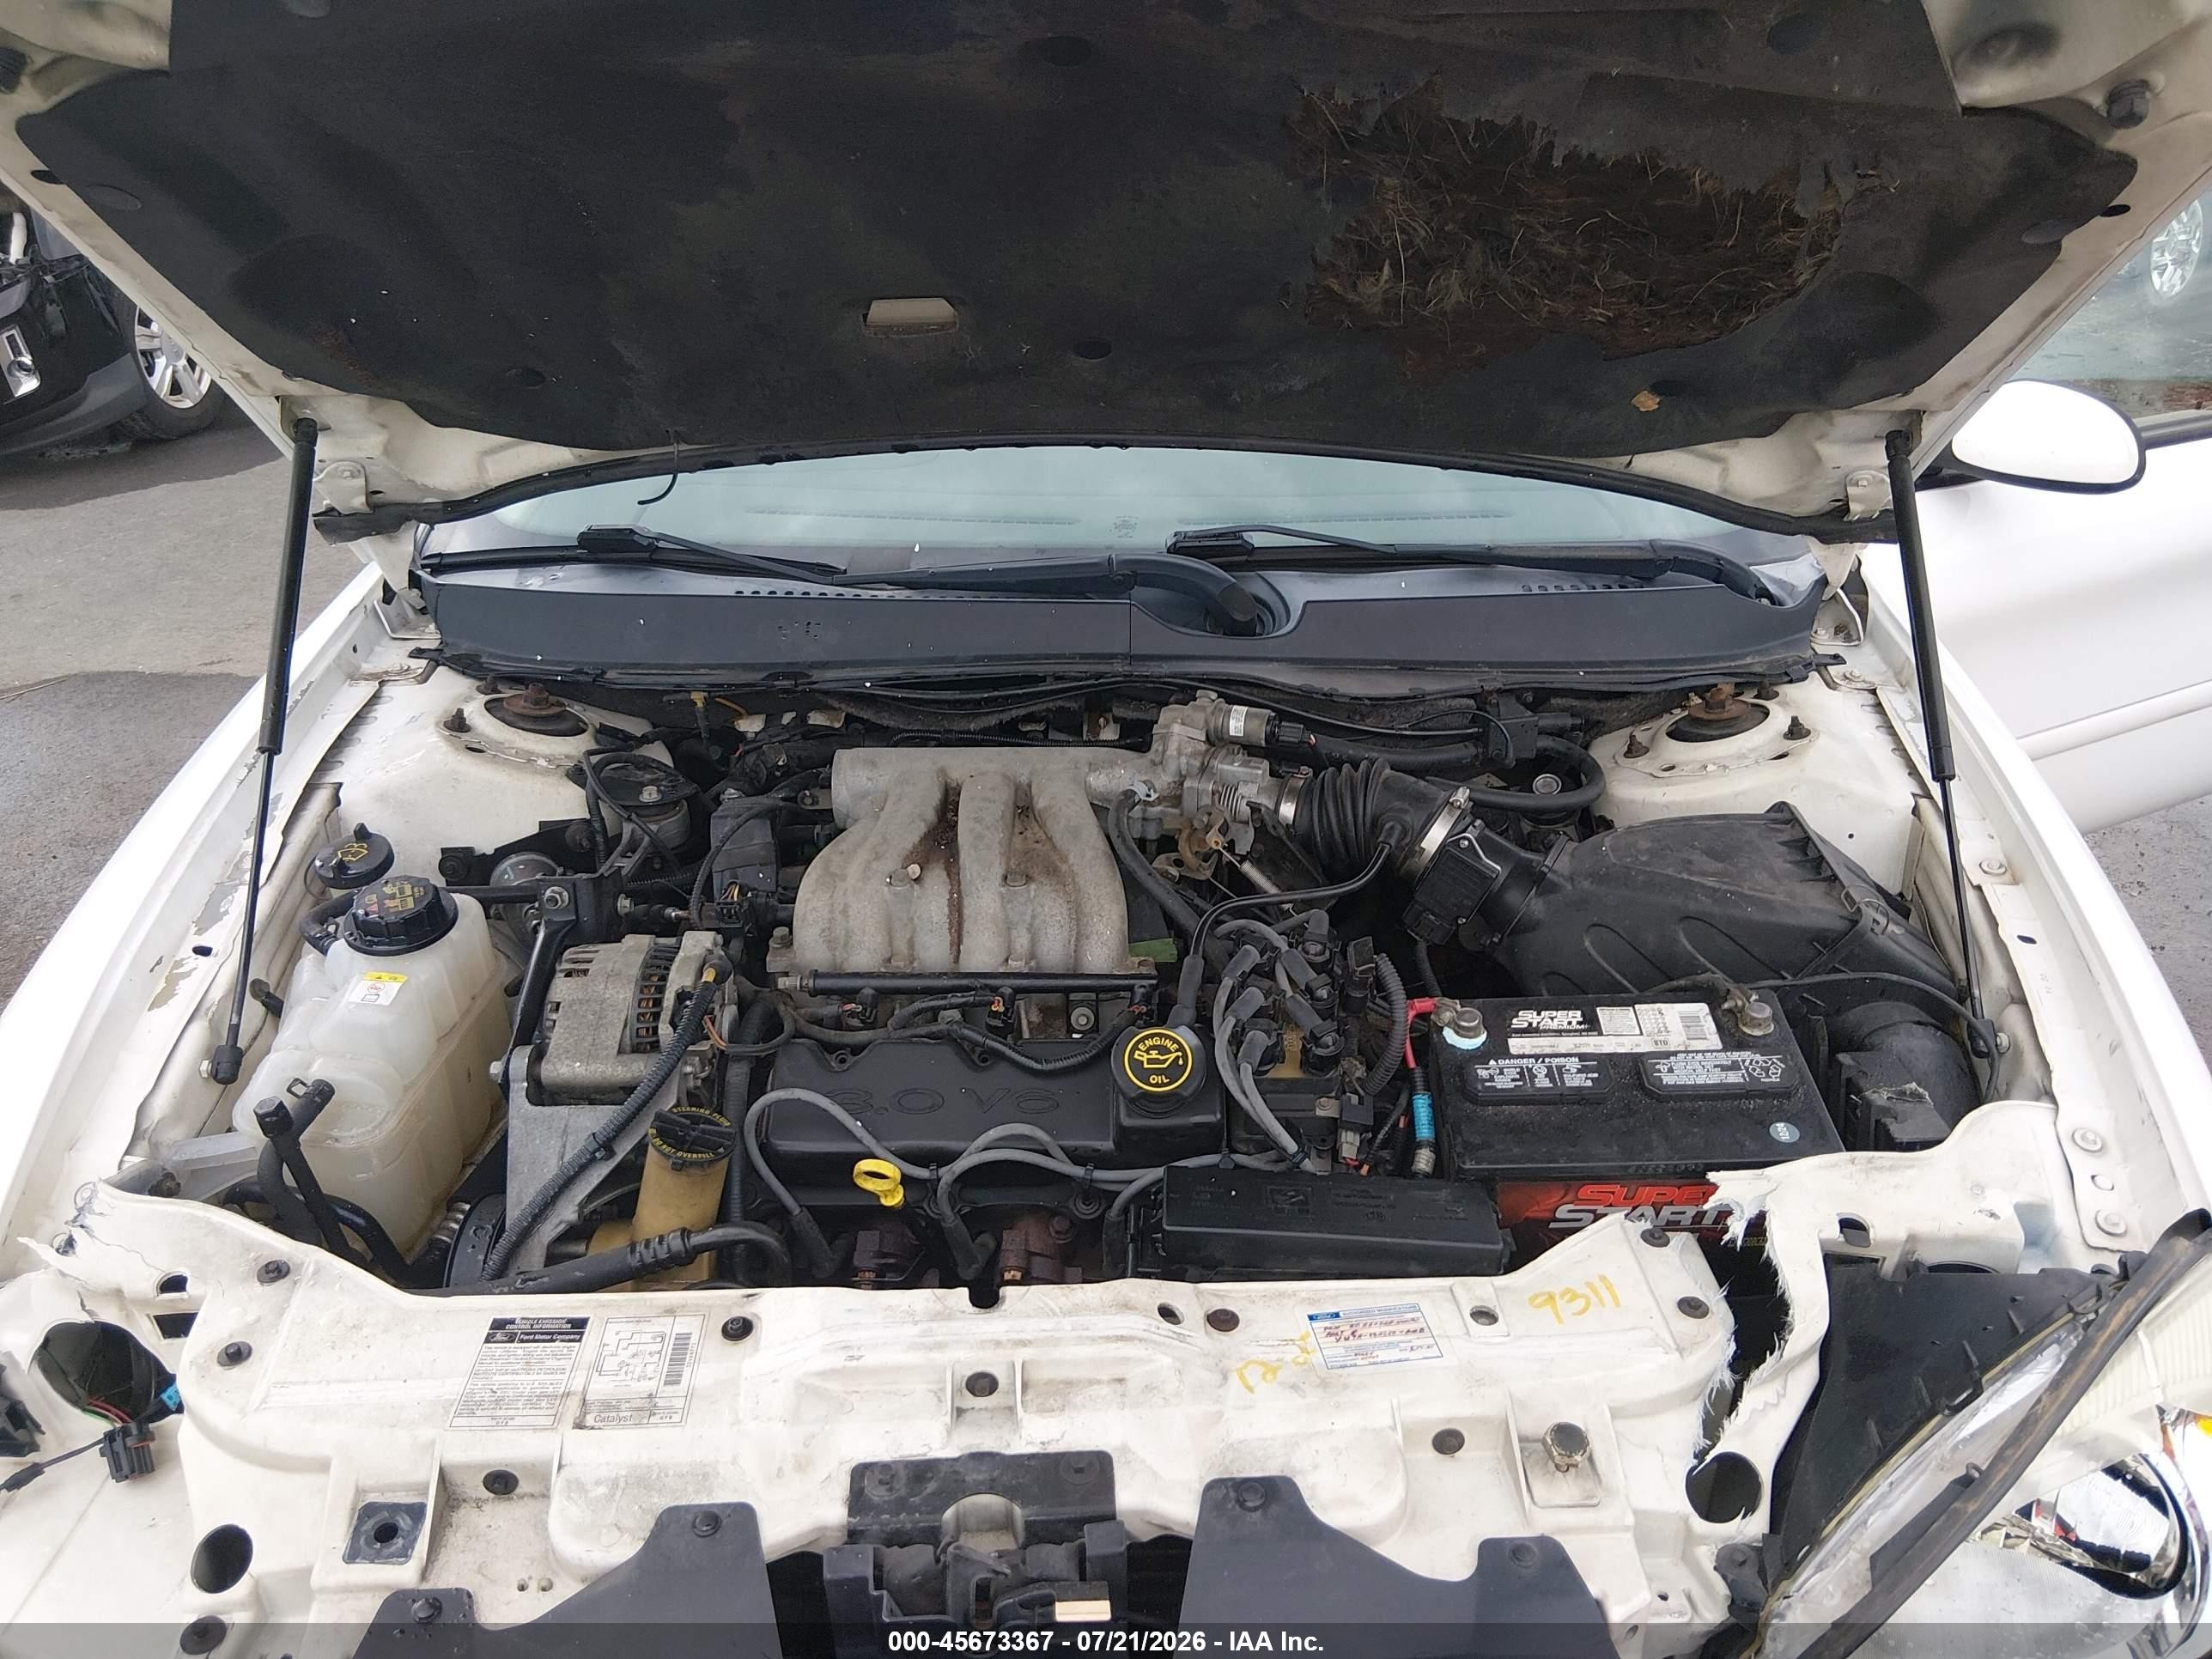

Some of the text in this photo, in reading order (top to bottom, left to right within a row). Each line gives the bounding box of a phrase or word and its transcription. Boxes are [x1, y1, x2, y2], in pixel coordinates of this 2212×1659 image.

[1517, 1010, 1582, 1019] SUPER
[1510, 1017, 1583, 1029] START
[1138, 1036, 1180, 1053] ENGINE
[1149, 1074, 1170, 1085] OIL
[963, 1087, 1060, 1115] V6
[672, 1106, 732, 1127] STEERING FLUID
[1528, 1273, 1622, 1325] 9311
[592, 1413, 633, 1424] Catalyst
